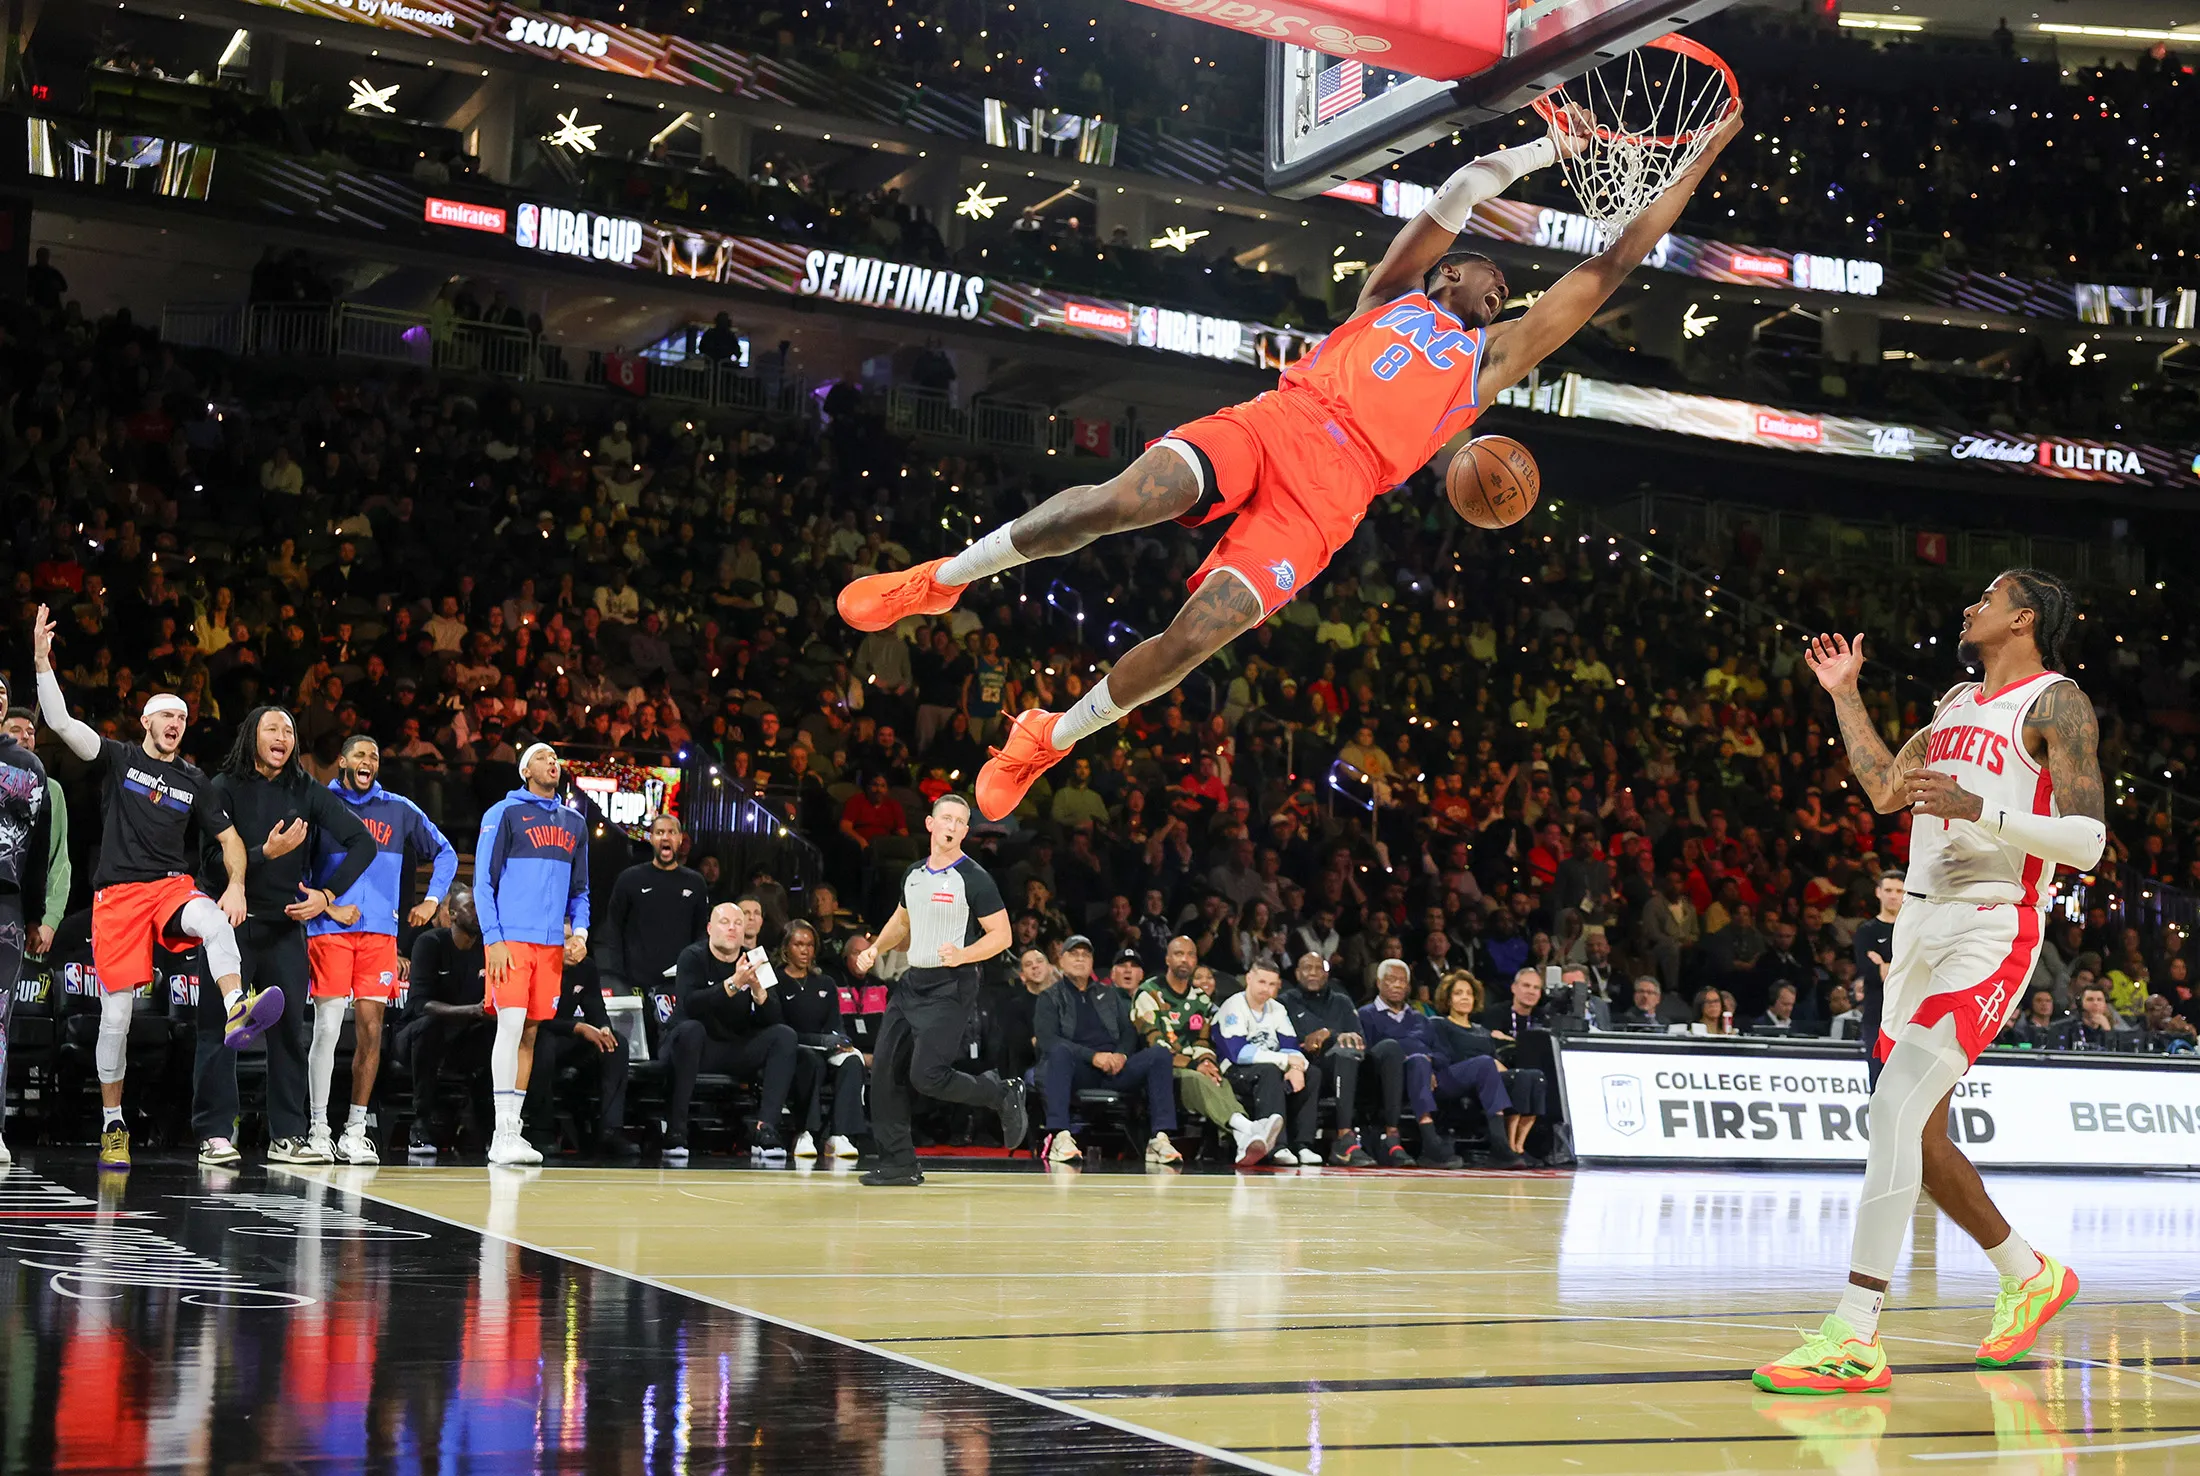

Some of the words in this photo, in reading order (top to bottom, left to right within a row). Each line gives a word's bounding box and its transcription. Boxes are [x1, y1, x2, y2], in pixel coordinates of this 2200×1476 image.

[358, 0, 379, 16] by
[381, 0, 455, 28] Microsoft
[1155, 0, 1310, 37] Stat
[505, 16, 609, 57] SKIMS
[430, 201, 501, 228] Emirates
[539, 206, 590, 257] NBA
[592, 215, 643, 264] CUP
[800, 249, 984, 321] SEMIFINALS
[1809, 254, 1847, 292] NBA
[1847, 259, 1883, 296] CUP
[1068, 306, 1127, 330] Emirates
[1156, 308, 1199, 355] NBA
[1200, 315, 1242, 360] CUP
[621, 361, 634, 386] 6
[1371, 343, 1412, 381] 8
[2055, 443, 2145, 475] ULTRA
[1925, 725, 2009, 776] ROCKETS
[610, 791, 646, 825] CUP
[524, 825, 576, 855] THUNDER
[1655, 1071, 1762, 1092] COLLEGE
[1770, 1075, 1871, 1094] FOOTBAL
[1659, 1100, 1807, 1141] FIRST
[2069, 1101, 2200, 1135] BEGIN
